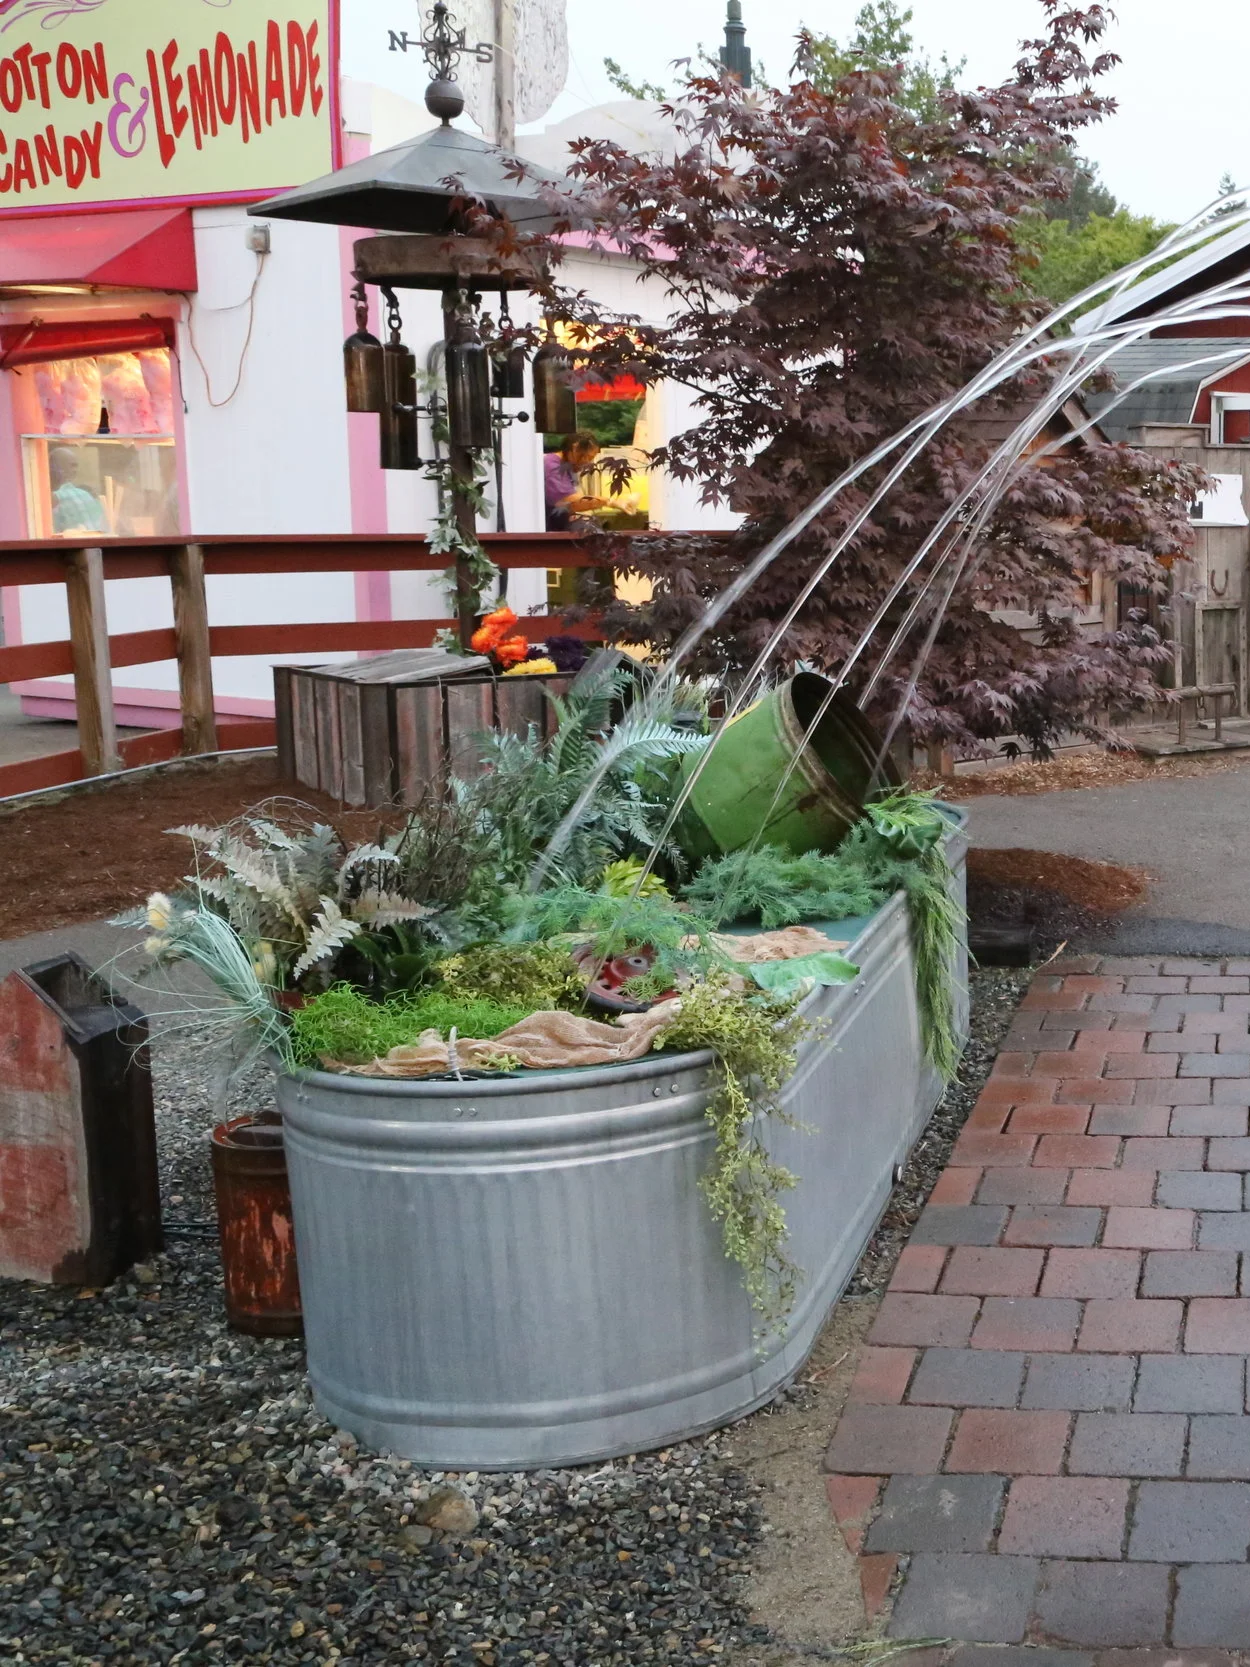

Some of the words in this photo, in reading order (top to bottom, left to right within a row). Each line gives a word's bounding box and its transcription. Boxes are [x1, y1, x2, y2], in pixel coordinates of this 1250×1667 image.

[388, 29, 408, 52] N
[476, 42, 493, 63] S
[107, 72, 150, 158] &
[146, 19, 324, 169] LEMONADE
